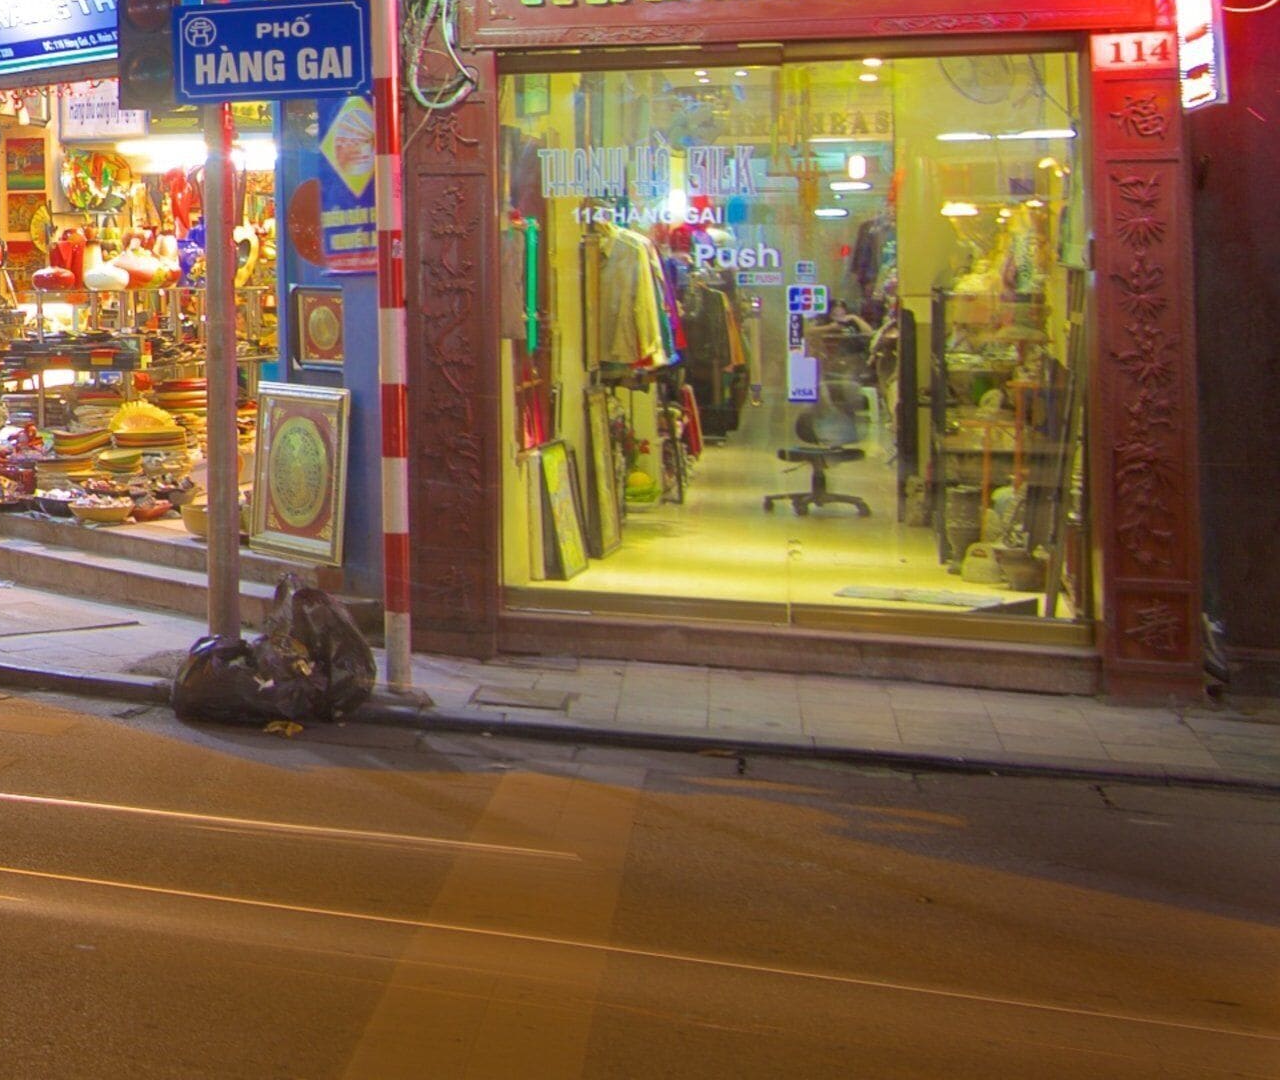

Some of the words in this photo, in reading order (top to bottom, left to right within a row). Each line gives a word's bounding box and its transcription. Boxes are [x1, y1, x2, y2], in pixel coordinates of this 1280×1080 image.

[255, 13, 312, 39] PHỐ
[1110, 38, 1172, 64] 114
[195, 45, 285, 85] HÀNG
[297, 45, 352, 80] GAI
[537, 144, 629, 198] THANH
[686, 144, 759, 198] SILK
[572, 206, 608, 224] 114
[683, 206, 723, 224] GAI
[694, 242, 781, 269] Push
[791, 387, 815, 397] VISA
